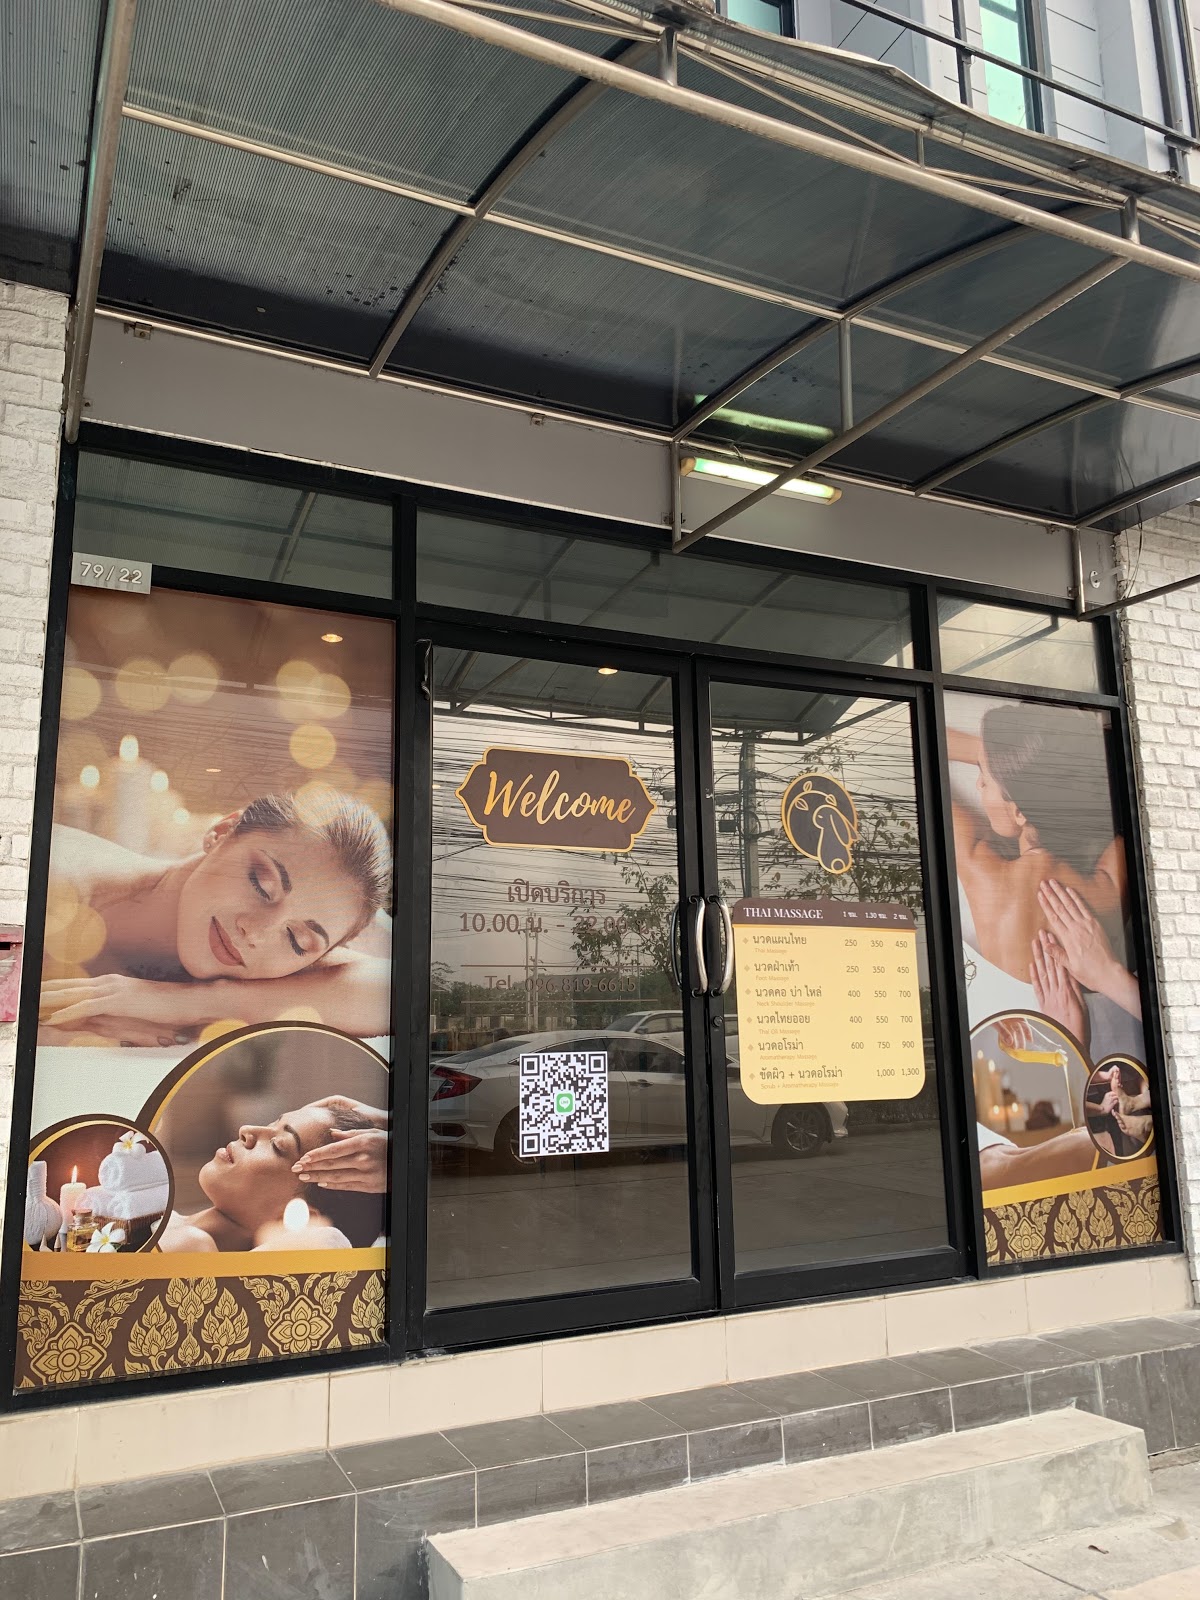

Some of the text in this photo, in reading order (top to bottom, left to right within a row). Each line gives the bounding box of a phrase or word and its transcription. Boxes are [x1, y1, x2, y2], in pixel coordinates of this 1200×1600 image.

[81, 562, 142, 584] 79/22
[483, 769, 636, 825] Welcome
[507, 878, 607, 906] เปิดบริการ
[743, 907, 824, 919] THAI MASSAGE
[460, 912, 520, 933] 10.00
[752, 932, 908, 949] นวดแผนไทย 250 350 450
[846, 965, 859, 973] 250
[872, 966, 885, 974] 350
[897, 966, 909, 974] 450
[790, 986, 802, 997] บ่า
[804, 985, 822, 997] ไหล่
[848, 990, 861, 998] 400
[874, 990, 887, 998] 550
[899, 990, 911, 998] 700
[757, 1011, 811, 1024] นวดไทยออย
[849, 1016, 863, 1024] 400
[875, 1016, 889, 1024] 550
[758, 1037, 914, 1051] นวดอโรม่า 600 750 900
[760, 1067, 785, 1080] ขัดผิว
[798, 1065, 843, 1079] นวดอโรม่า
[876, 1069, 895, 1078] 1,000
[901, 1067, 920, 1077] 1,300
